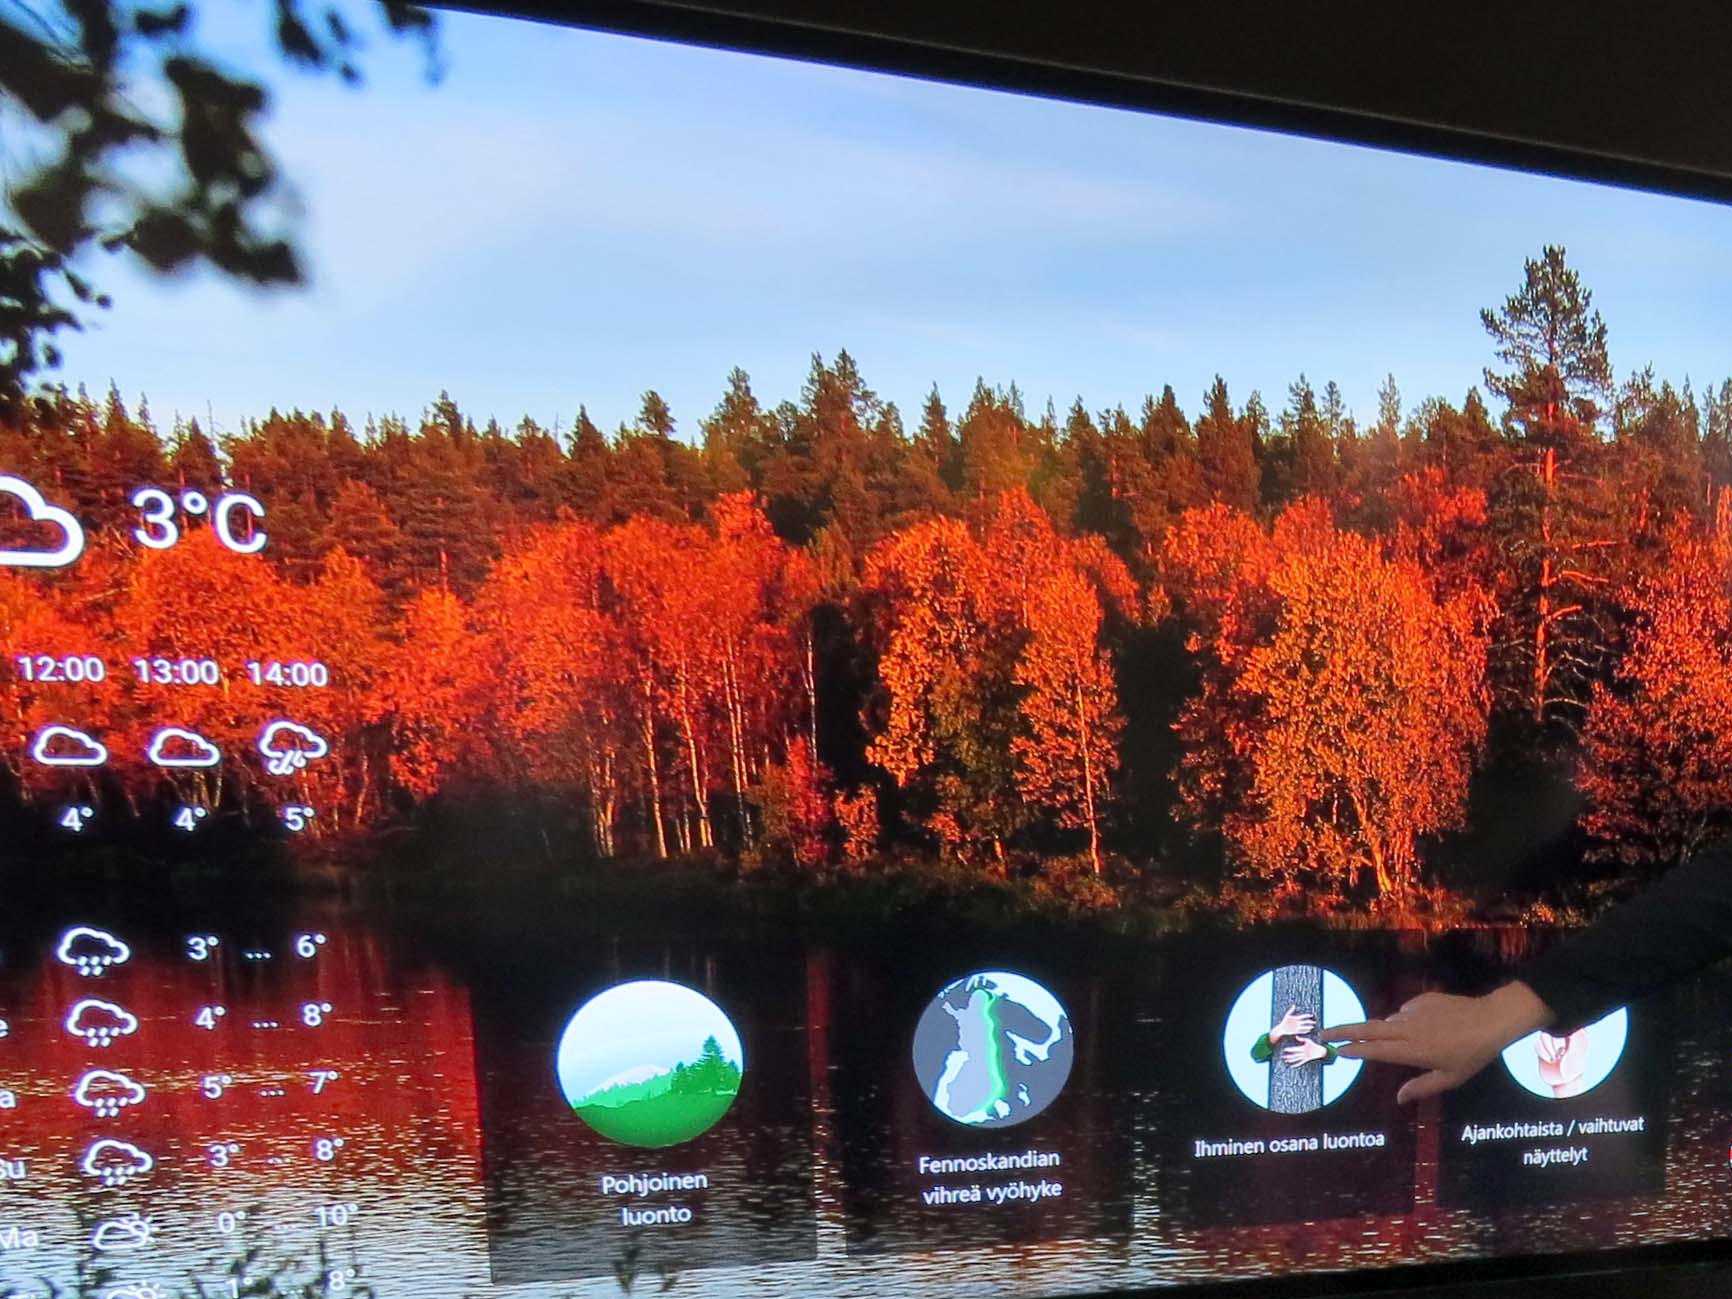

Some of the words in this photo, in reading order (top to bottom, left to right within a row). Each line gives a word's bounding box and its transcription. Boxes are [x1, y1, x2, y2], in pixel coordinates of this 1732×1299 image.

[131, 490, 268, 555] 3°C
[18, 656, 106, 683] 12:00
[135, 658, 220, 686] 13:00
[248, 661, 329, 687] 14:00
[61, 806, 94, 833] 4°
[175, 806, 207, 832] 4°
[285, 806, 315, 832] 5°
[187, 935, 219, 960] 3°
[297, 933, 327, 958] 6°
[195, 1004, 226, 1030] 4°
[302, 1002, 333, 1027] 8°
[202, 1074, 233, 1099] 5°
[308, 1069, 339, 1095] 7°
[1460, 1118, 1564, 1145] Ajankohtaista
[1565, 1118, 1575, 1137] /
[1577, 1114, 1645, 1137] vaihtuvat
[209, 1143, 240, 1168] 3°
[314, 1137, 345, 1162] 8°
[1194, 1138, 1265, 1158] Ihminen
[1268, 1136, 1319, 1153] osana
[1323, 1131, 1385, 1149] luontoa
[1523, 1144, 1589, 1169] näyttelyt
[919, 1148, 1061, 1176] Fennoskandian
[601, 1169, 708, 1198] Pohjoinen
[922, 1182, 982, 1206] vihreä
[985, 1178, 1063, 1205] vyöhyke
[216, 1210, 247, 1234] 0°
[318, 1203, 358, 1228] 10°
[622, 1203, 692, 1227] luonto
[226, 1276, 252, 1299] 1°
[328, 1268, 356, 1291] 8°
